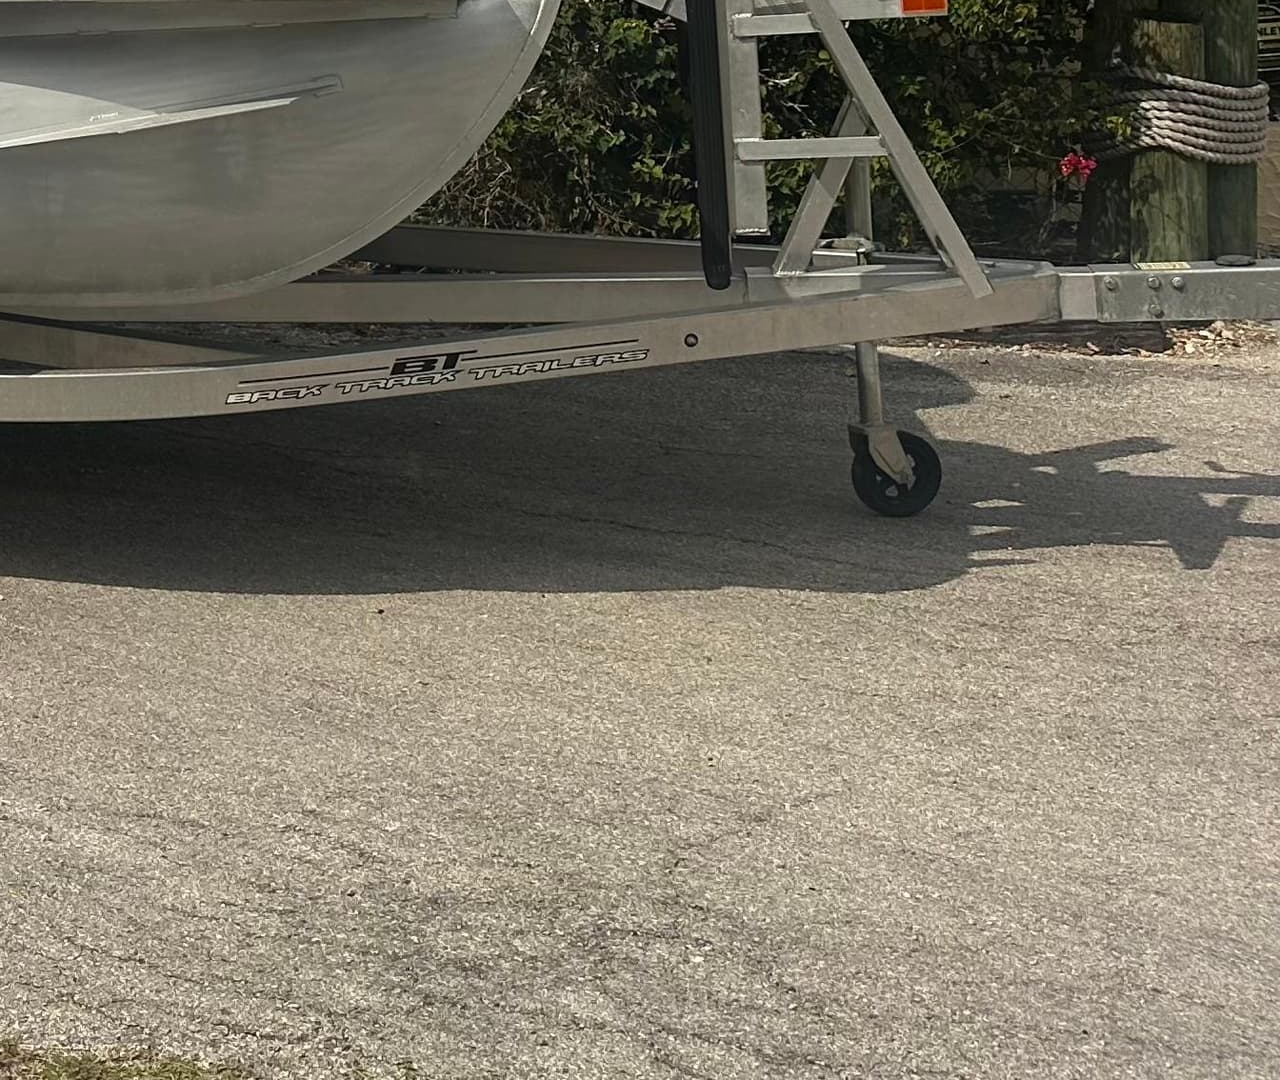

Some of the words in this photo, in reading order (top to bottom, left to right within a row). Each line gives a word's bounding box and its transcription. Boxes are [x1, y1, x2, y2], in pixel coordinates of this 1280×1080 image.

[225, 383, 330, 405] BACK
[336, 369, 464, 395] TRACK
[468, 349, 650, 380] TRAILERS
[390, 350, 477, 376] BT
